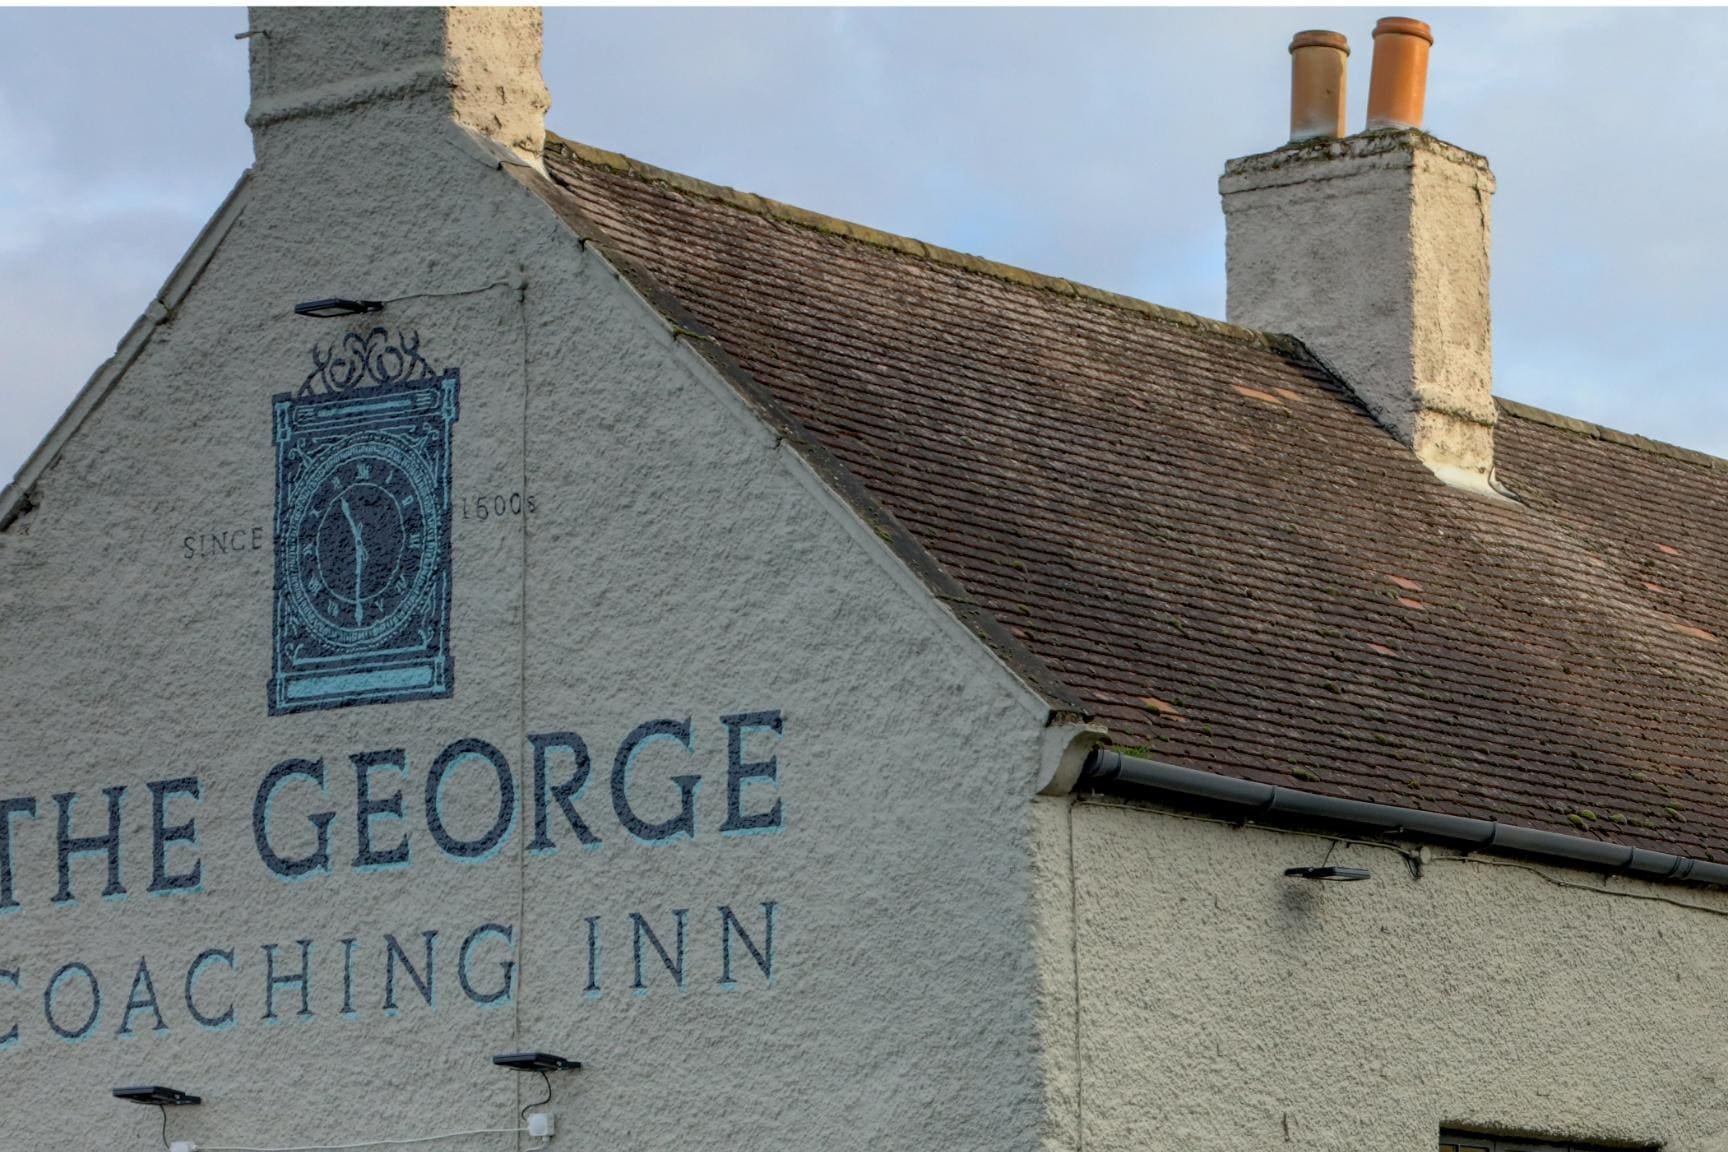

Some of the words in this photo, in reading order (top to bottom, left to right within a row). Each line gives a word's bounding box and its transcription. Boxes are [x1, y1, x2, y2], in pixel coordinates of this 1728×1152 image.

[184, 526, 264, 560] SINCE
[461, 492, 537, 521] 1500s
[0, 776, 204, 914] THE
[252, 709, 785, 884] GEORGE
[583, 901, 779, 999] INN
